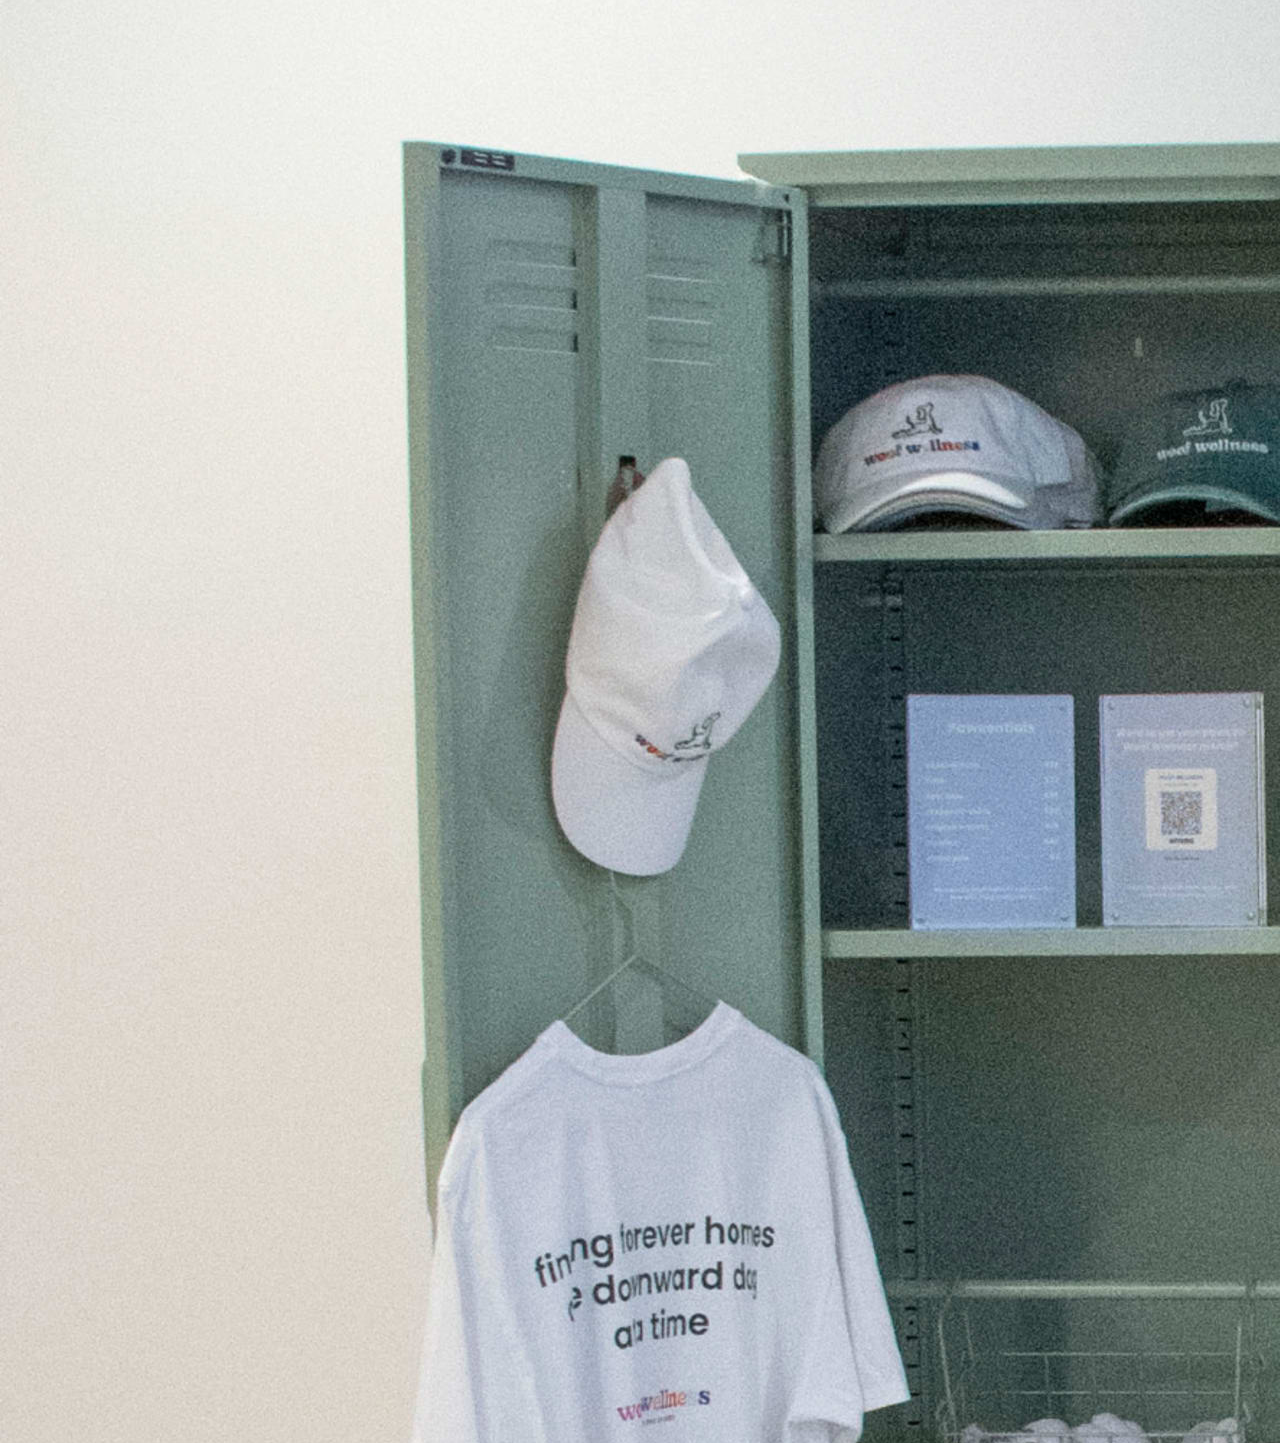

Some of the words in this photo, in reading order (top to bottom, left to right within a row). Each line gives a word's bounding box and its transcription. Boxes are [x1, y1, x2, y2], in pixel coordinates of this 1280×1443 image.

[905, 438, 980, 454] wllness
[1194, 439, 1269, 455] wellness
[535, 1233, 615, 1288] finng
[620, 1222, 696, 1255] forever
[705, 1215, 775, 1248] homes
[651, 1309, 709, 1340] time
